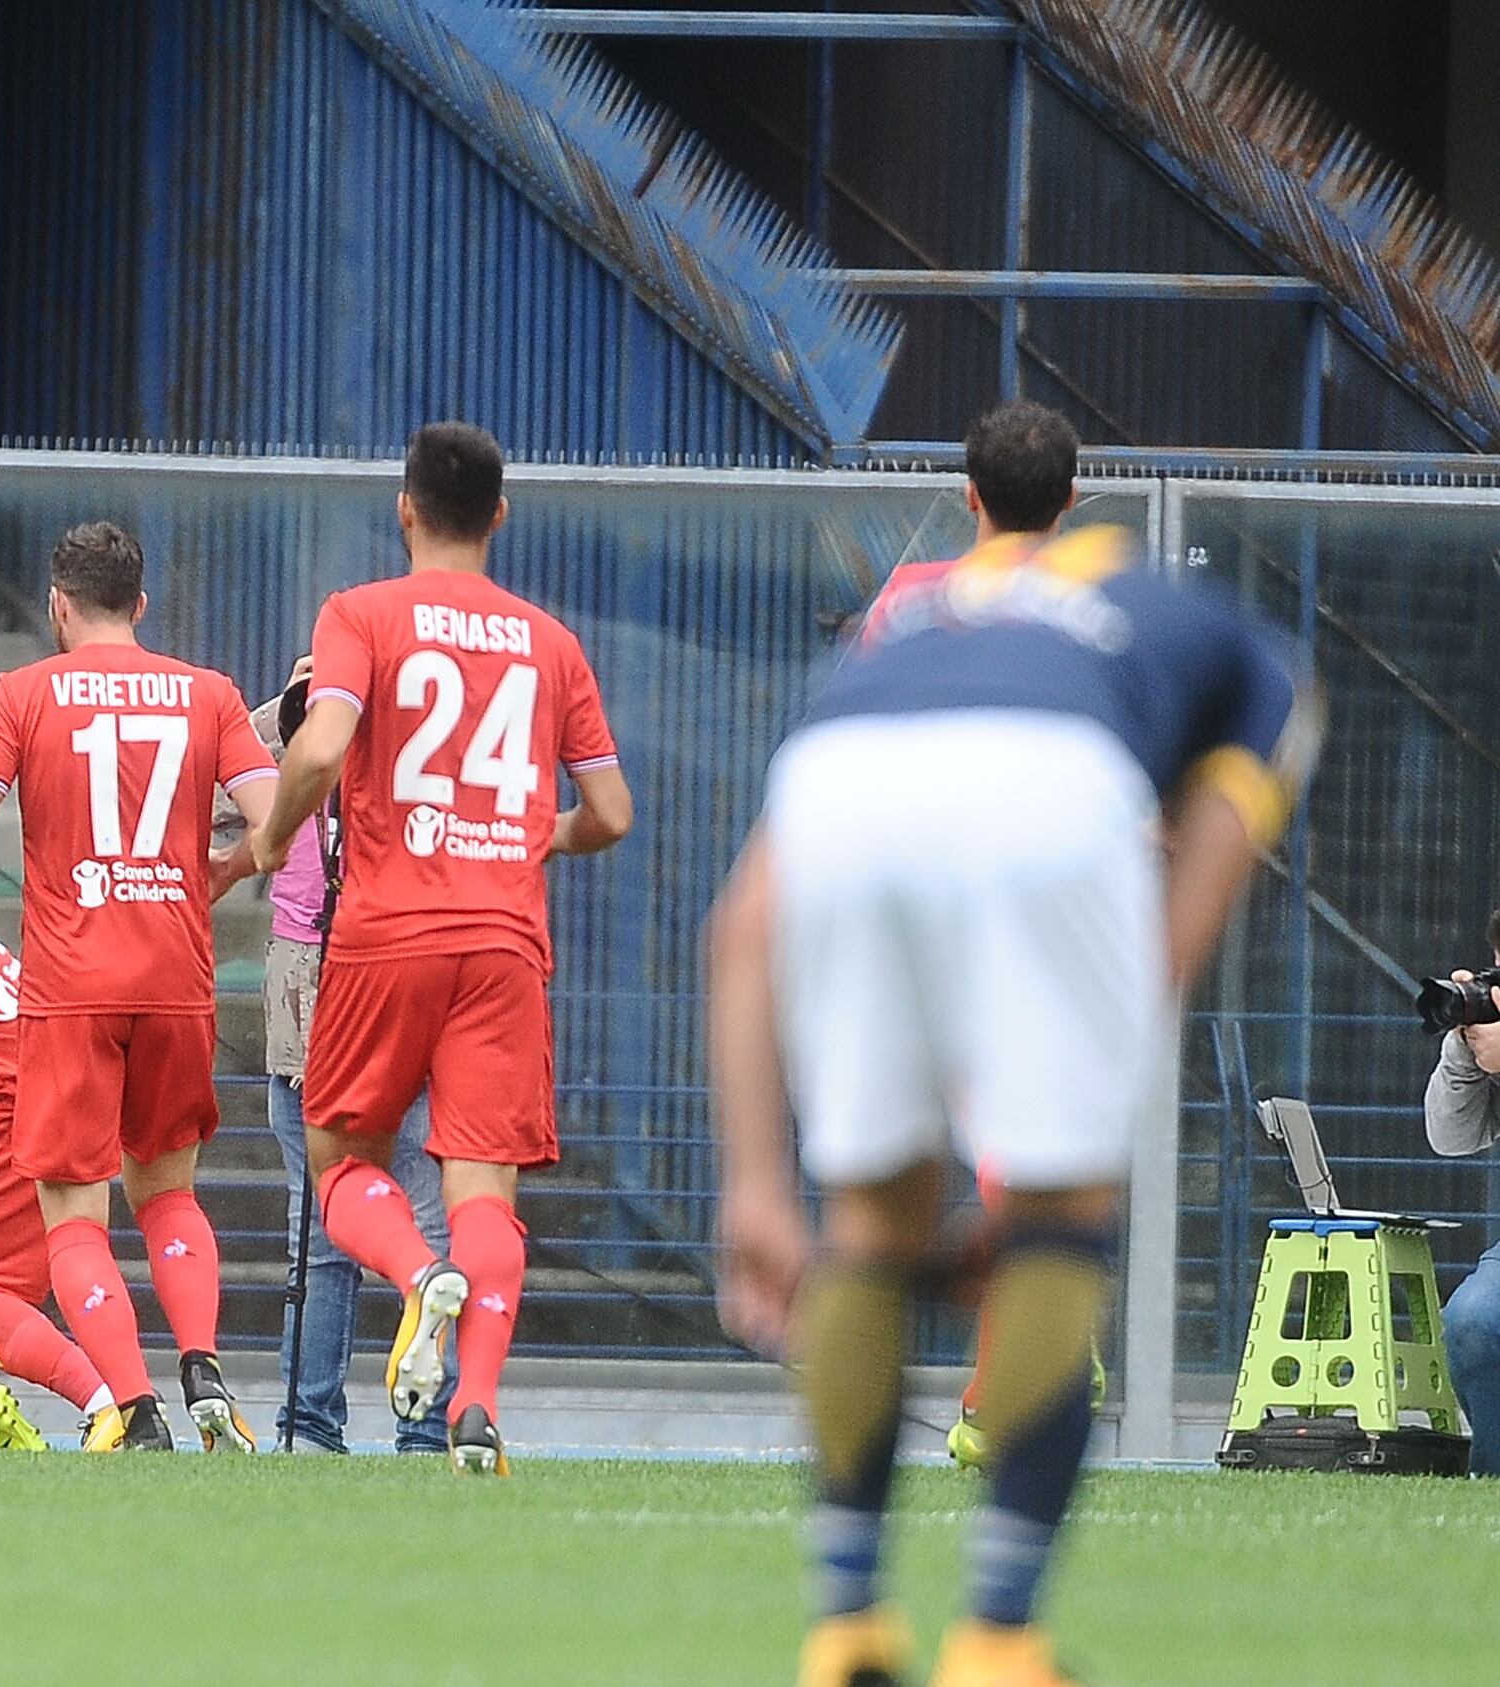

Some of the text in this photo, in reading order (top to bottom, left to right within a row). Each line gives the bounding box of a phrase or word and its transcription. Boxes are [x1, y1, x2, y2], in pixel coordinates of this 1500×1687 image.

[413, 603, 532, 657] BENASSI
[50, 671, 194, 708] VERETOUT
[393, 650, 539, 817] 24
[72, 713, 189, 858] 17
[446, 812, 526, 842] Save the
[445, 835, 528, 862] Children
[111, 861, 183, 882] Save the
[113, 882, 187, 902] Children
